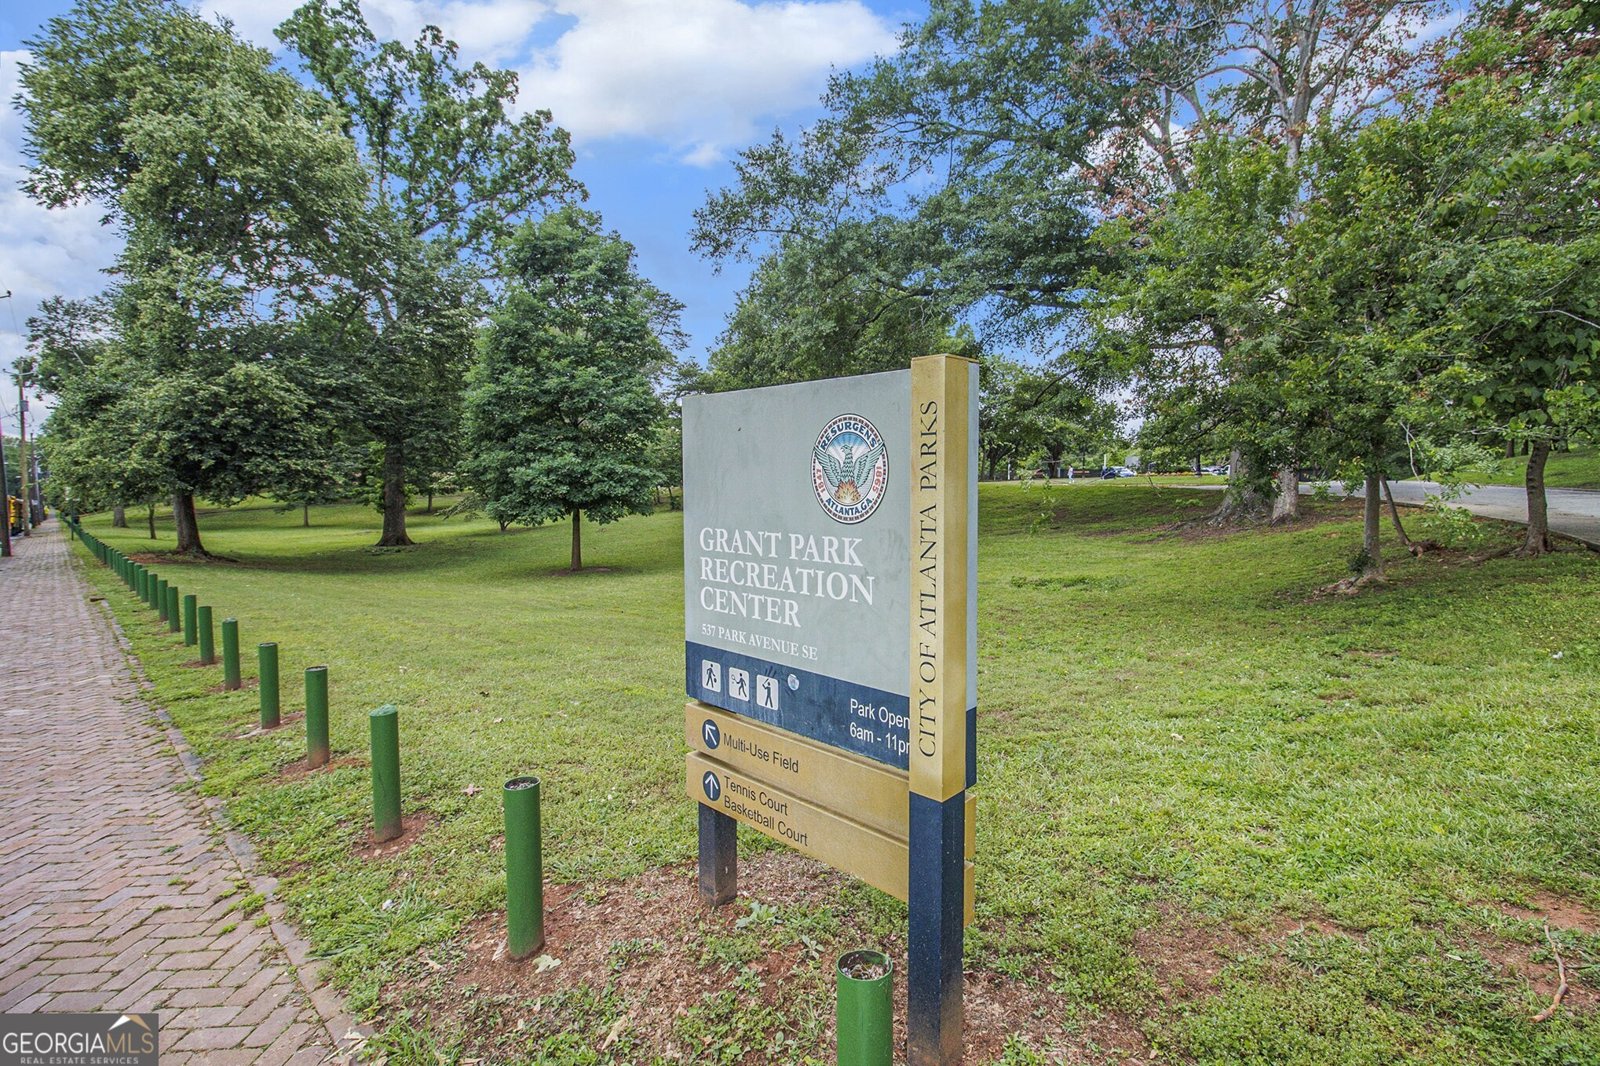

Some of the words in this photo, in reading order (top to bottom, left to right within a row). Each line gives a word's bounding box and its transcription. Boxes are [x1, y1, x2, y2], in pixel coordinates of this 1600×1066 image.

[820, 421, 877, 450] RESURGENS
[919, 400, 938, 491] PARKS
[872, 465, 883, 493] 1865
[699, 527, 781, 558] GRANT
[788, 533, 864, 567] PARK
[700, 557, 875, 605] RECREATION
[919, 503, 937, 636] ATLANTA
[699, 585, 802, 628] CENTER
[701, 624, 716, 636] 537
[718, 627, 747, 644] PARK
[748, 634, 799, 656] AVENUE
[802, 646, 818, 659] SE
[919, 643, 936, 684] OF
[850, 698, 876, 720] Park
[919, 690, 936, 757] CITY
[849, 721, 874, 743] 6am
[723, 733, 770, 761] Multi-Use
[772, 752, 799, 773] Field
[723, 775, 757, 802] Tennis
[758, 790, 789, 817] Court
[723, 796, 776, 831] Basketball
[777, 819, 809, 848] Court
